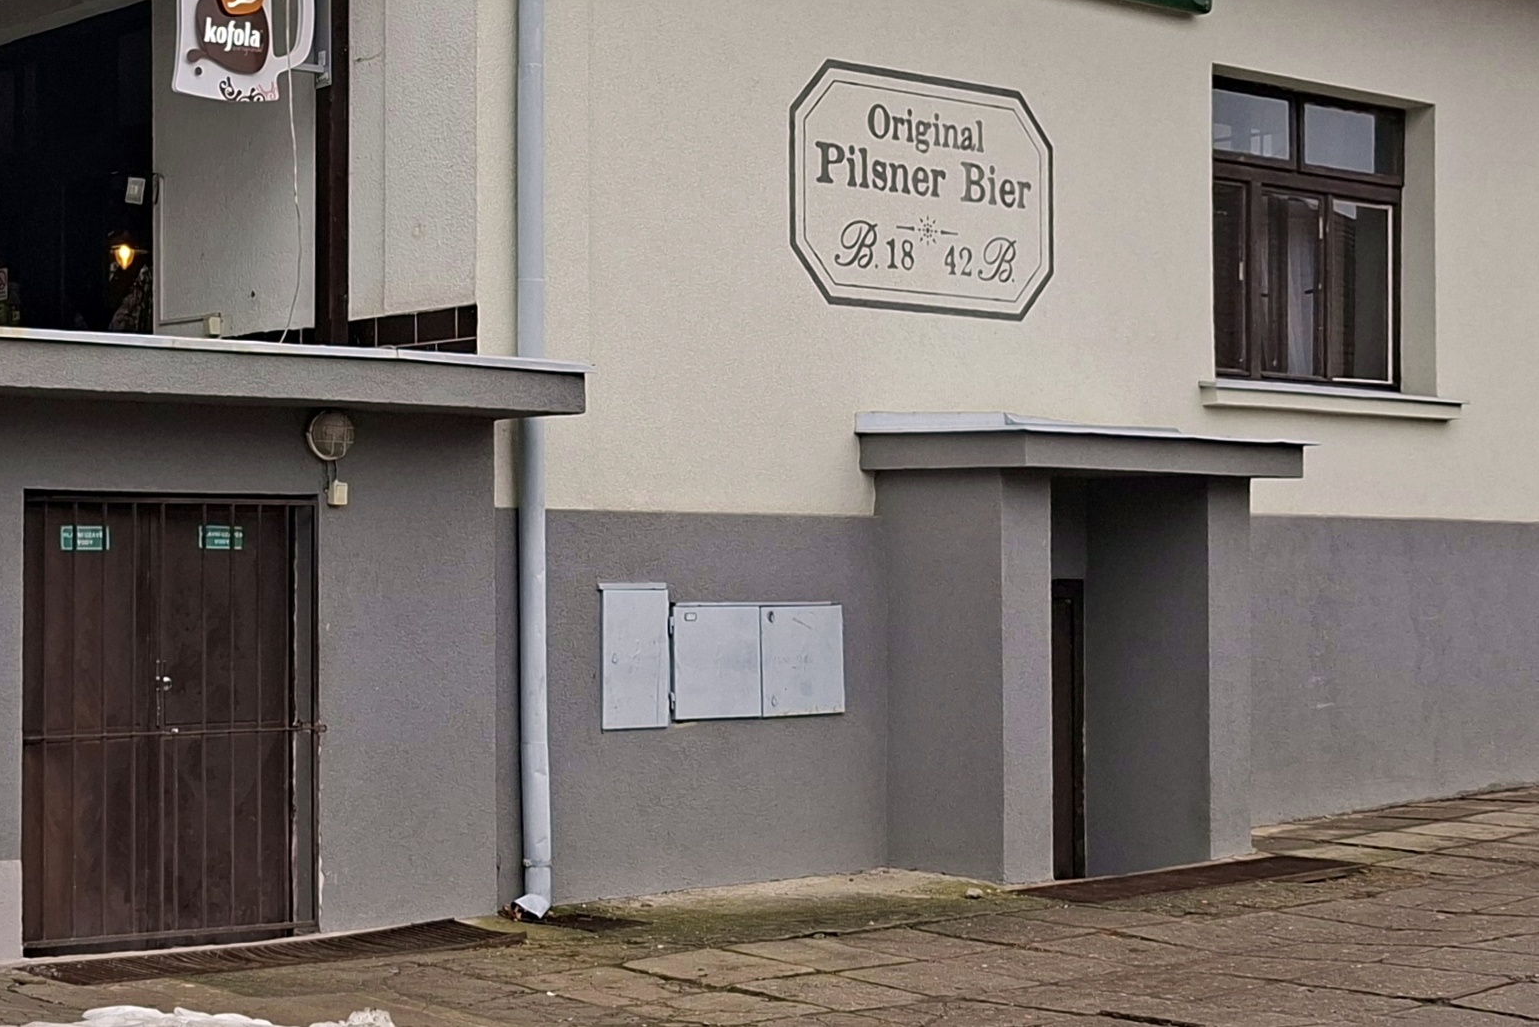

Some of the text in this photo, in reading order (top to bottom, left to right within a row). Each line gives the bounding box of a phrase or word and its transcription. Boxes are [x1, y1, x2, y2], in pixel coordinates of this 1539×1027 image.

[203, 16, 261, 52] kofola
[867, 103, 985, 154] Original
[815, 140, 1032, 210] Pilsner Bier
